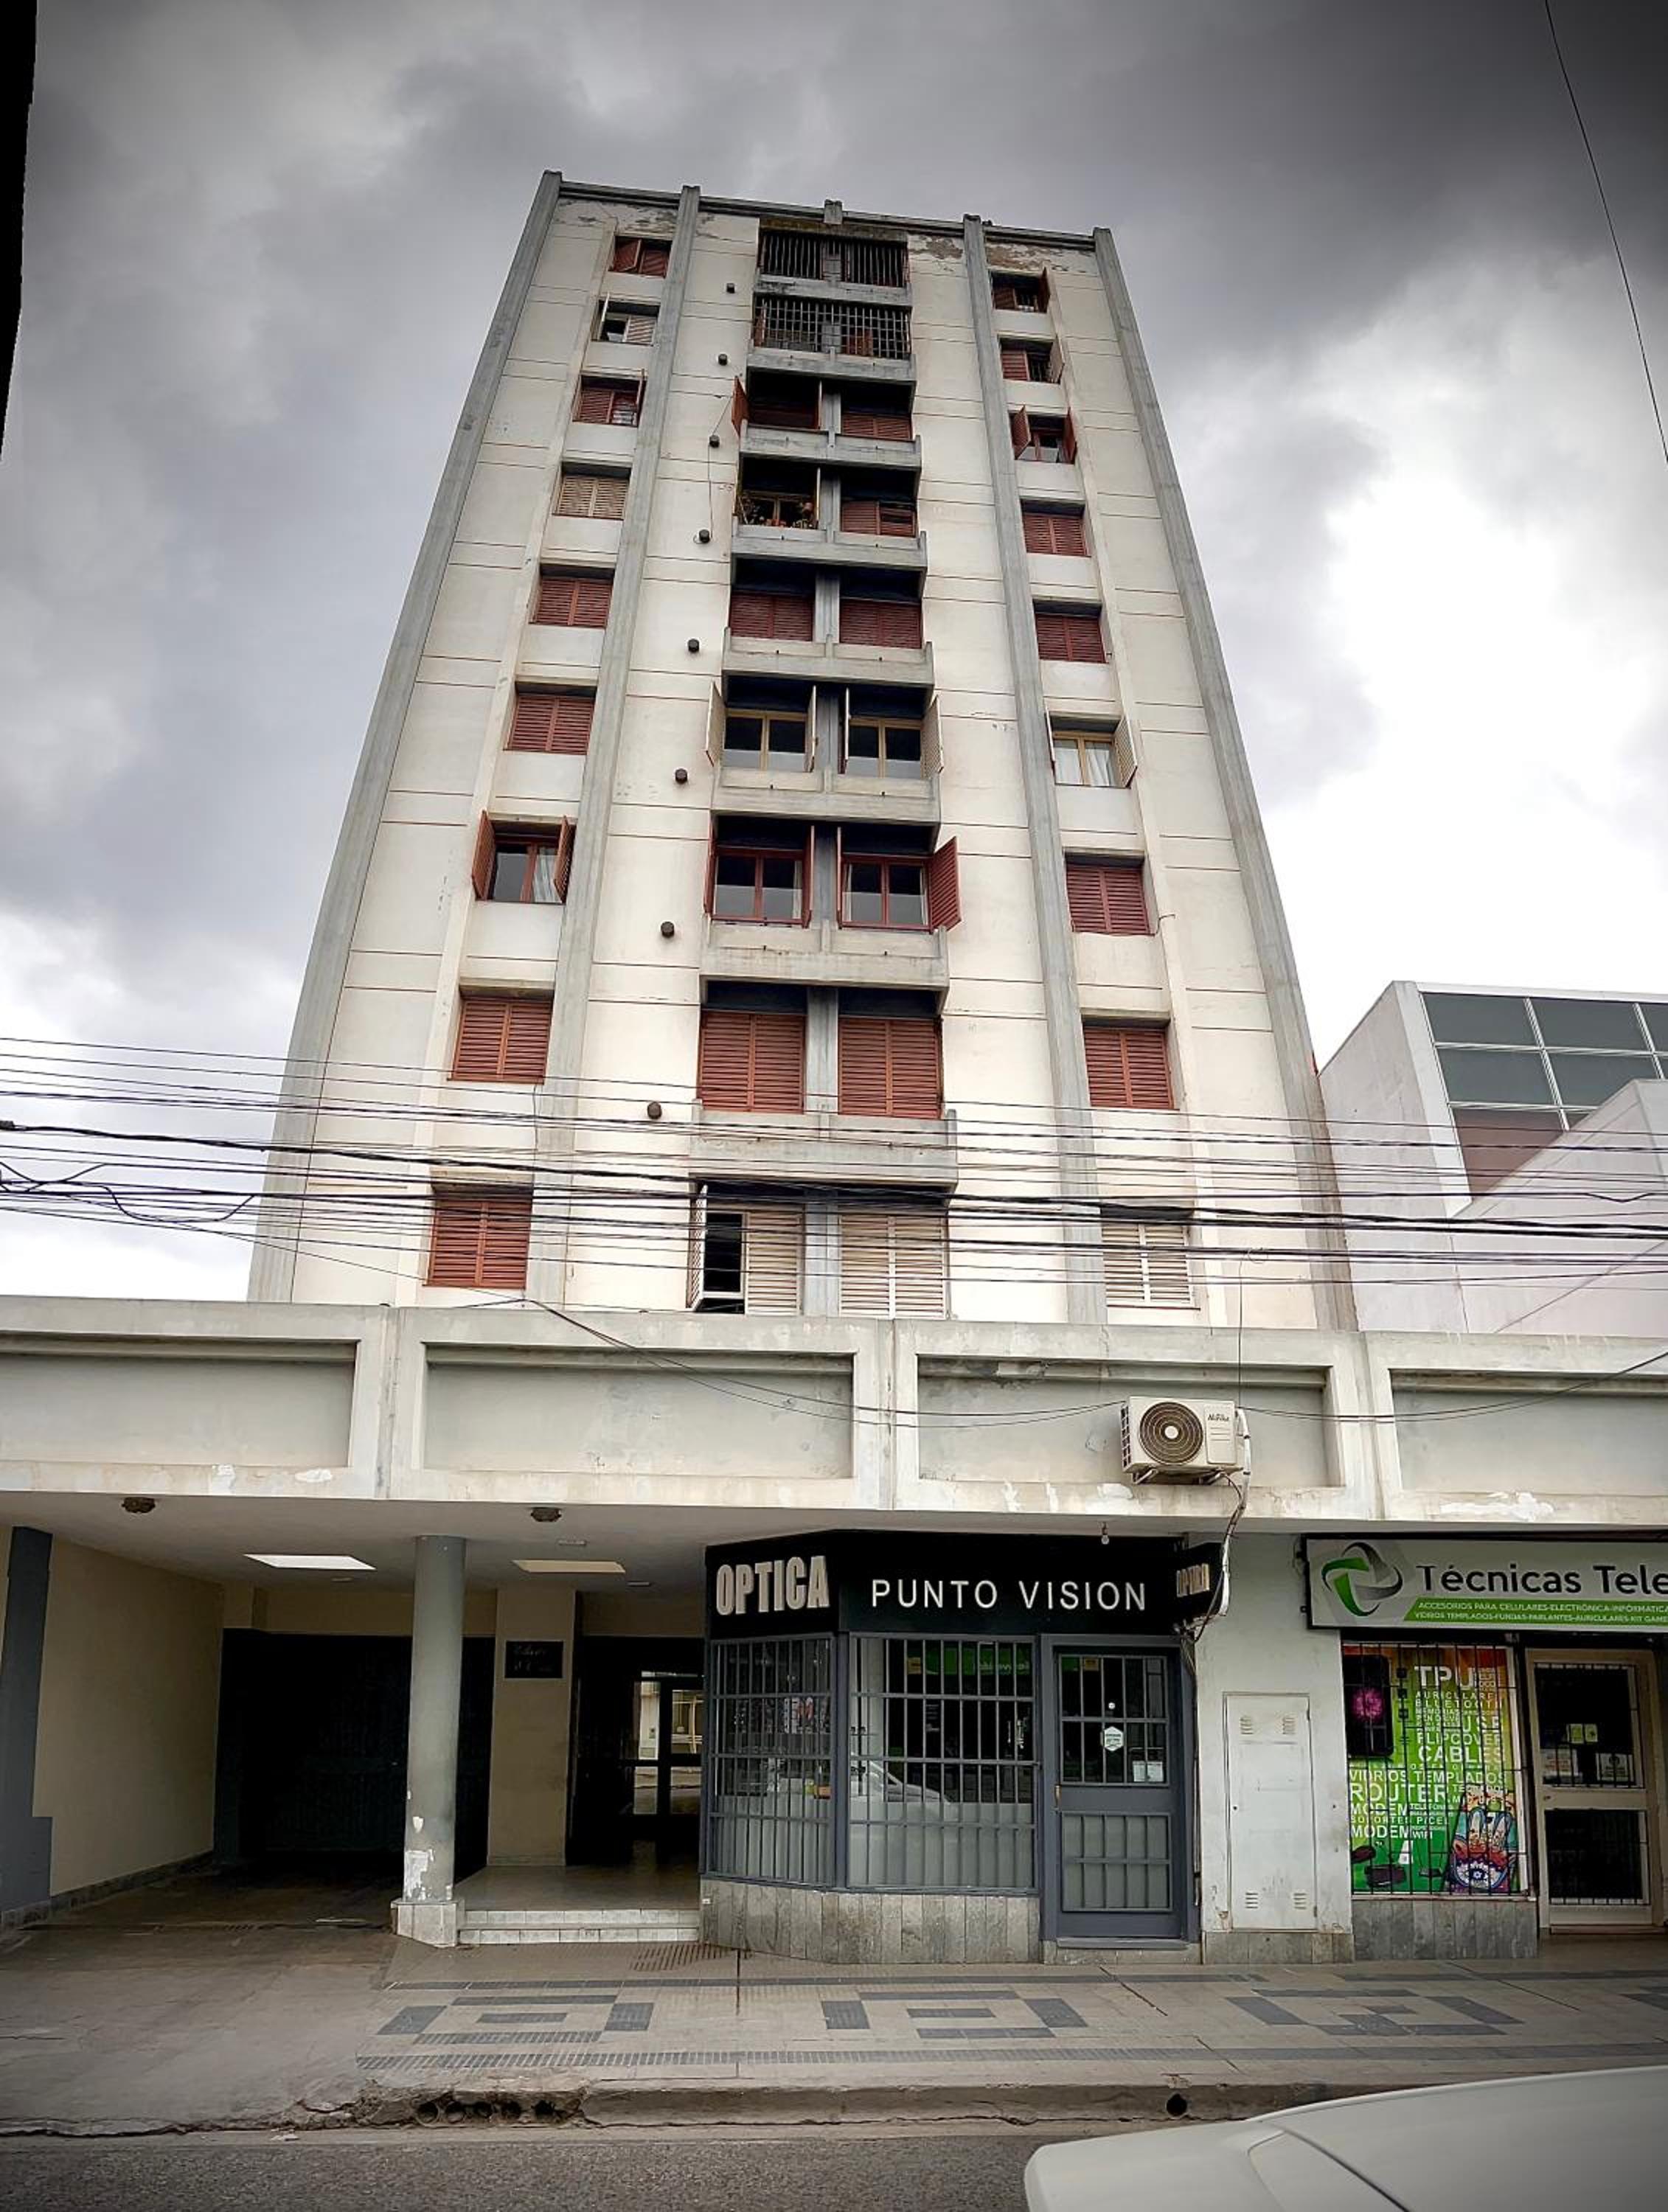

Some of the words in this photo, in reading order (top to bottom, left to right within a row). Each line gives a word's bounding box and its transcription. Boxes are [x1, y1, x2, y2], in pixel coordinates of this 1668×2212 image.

[716, 1555, 830, 1616] OPTICA
[1415, 1562, 1582, 1593] Técnicas
[1592, 1564, 1668, 1595] Tele
[871, 1579, 998, 1609] PUNTO
[1018, 1580, 1146, 1611] VISION
[1418, 1601, 1473, 1610] ACCESORIOS
[1474, 1602, 1497, 1611] PARA
[1418, 1745, 1505, 1764] CABLES
[1349, 1770, 1407, 1783] VIDRIOS
[1414, 1770, 1507, 1784] TEMPLADOS
[1351, 1825, 1410, 1838] MODEM
